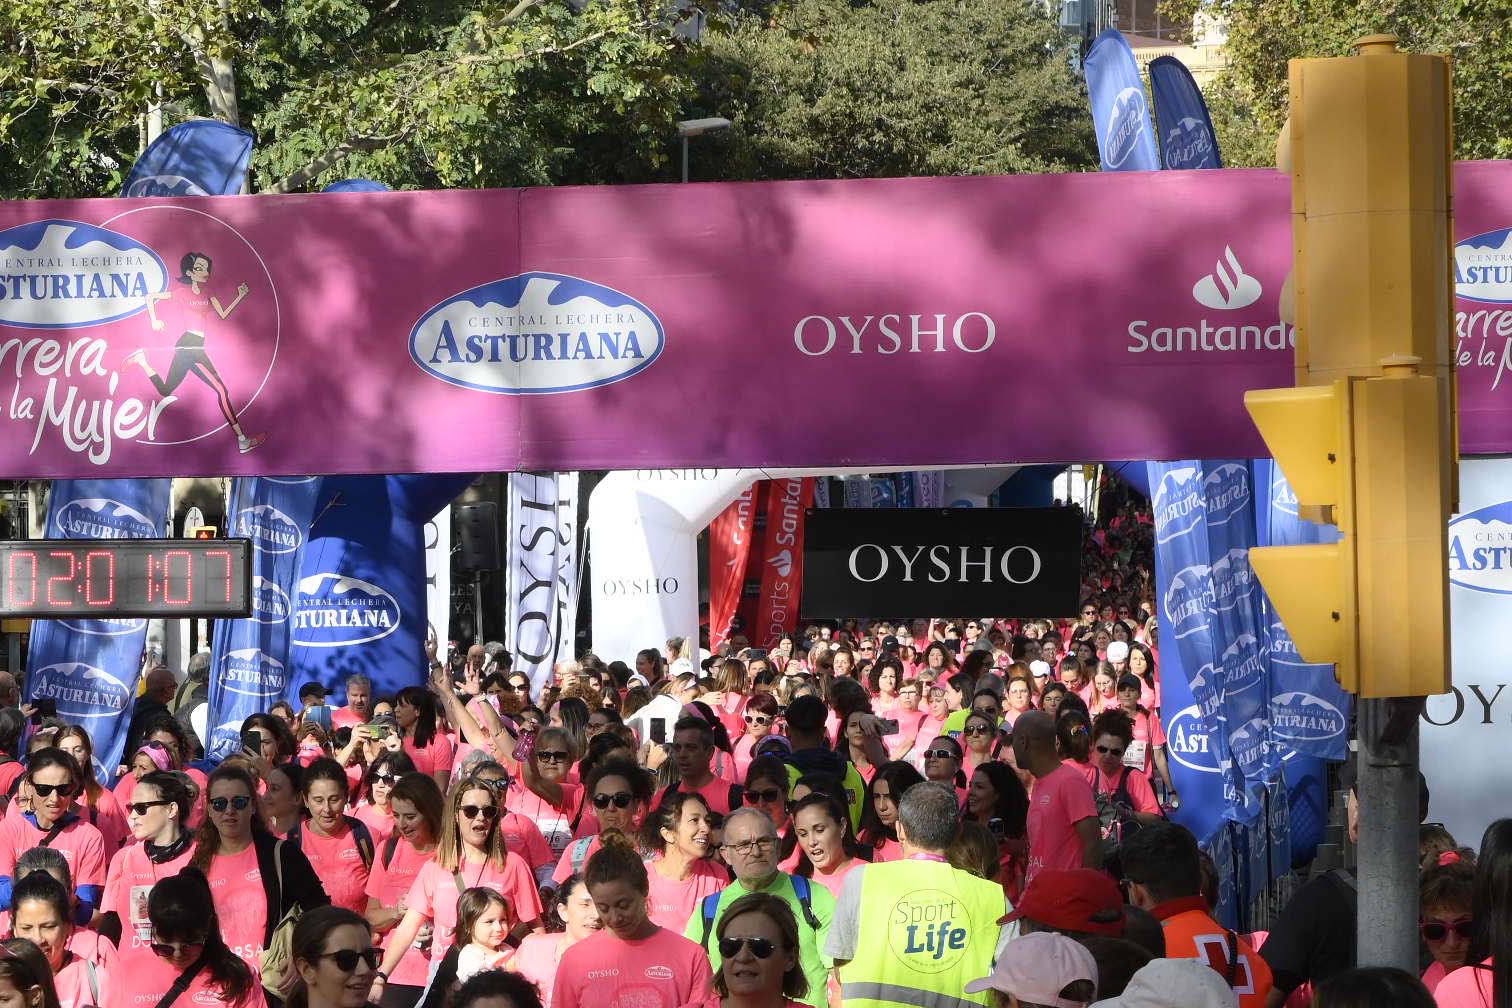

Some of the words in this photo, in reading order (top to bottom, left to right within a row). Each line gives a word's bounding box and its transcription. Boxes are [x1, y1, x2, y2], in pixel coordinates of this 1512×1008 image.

[71, 255, 144, 267] LECHERA
[468, 314, 547, 329] CENTRAL
[556, 312, 637, 326] LECHERA
[793, 312, 996, 356] OYSHO
[429, 319, 644, 364] ASTURIANA
[9, 384, 35, 420] la
[29, 369, 178, 466] Mujer
[7, 550, 232, 607] 02:01:07
[848, 543, 1042, 585] OYSHO
[338, 598, 387, 607] LECHERA
[603, 577, 680, 597] OYSHO
[36, 675, 123, 709] ASTURIANA
[895, 899, 956, 926] Sport
[904, 921, 967, 960] Life
